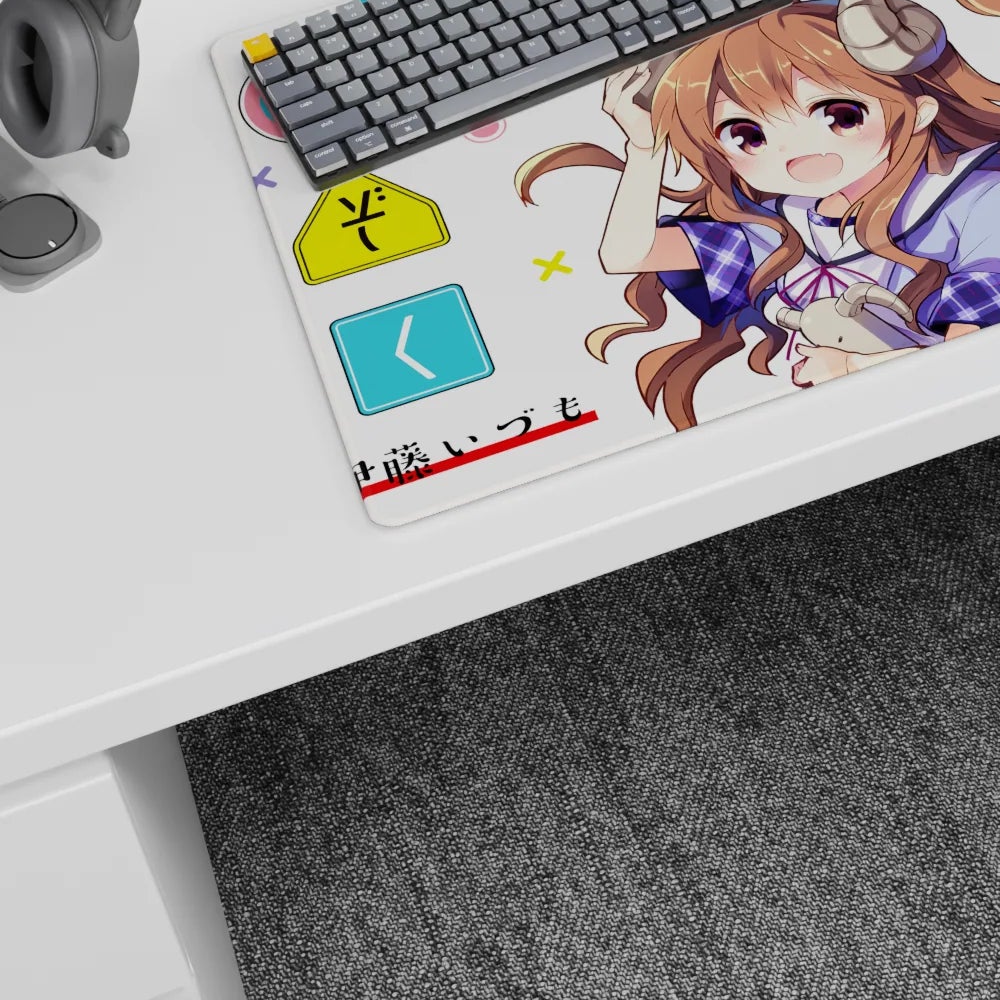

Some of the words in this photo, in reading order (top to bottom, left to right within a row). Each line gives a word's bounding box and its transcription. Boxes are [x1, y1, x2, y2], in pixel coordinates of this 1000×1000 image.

[299, 100, 313, 108] caps
[320, 119, 335, 128] shift
[391, 114, 418, 127] command
[356, 133, 374, 142] option
[314, 146, 335, 158] control
